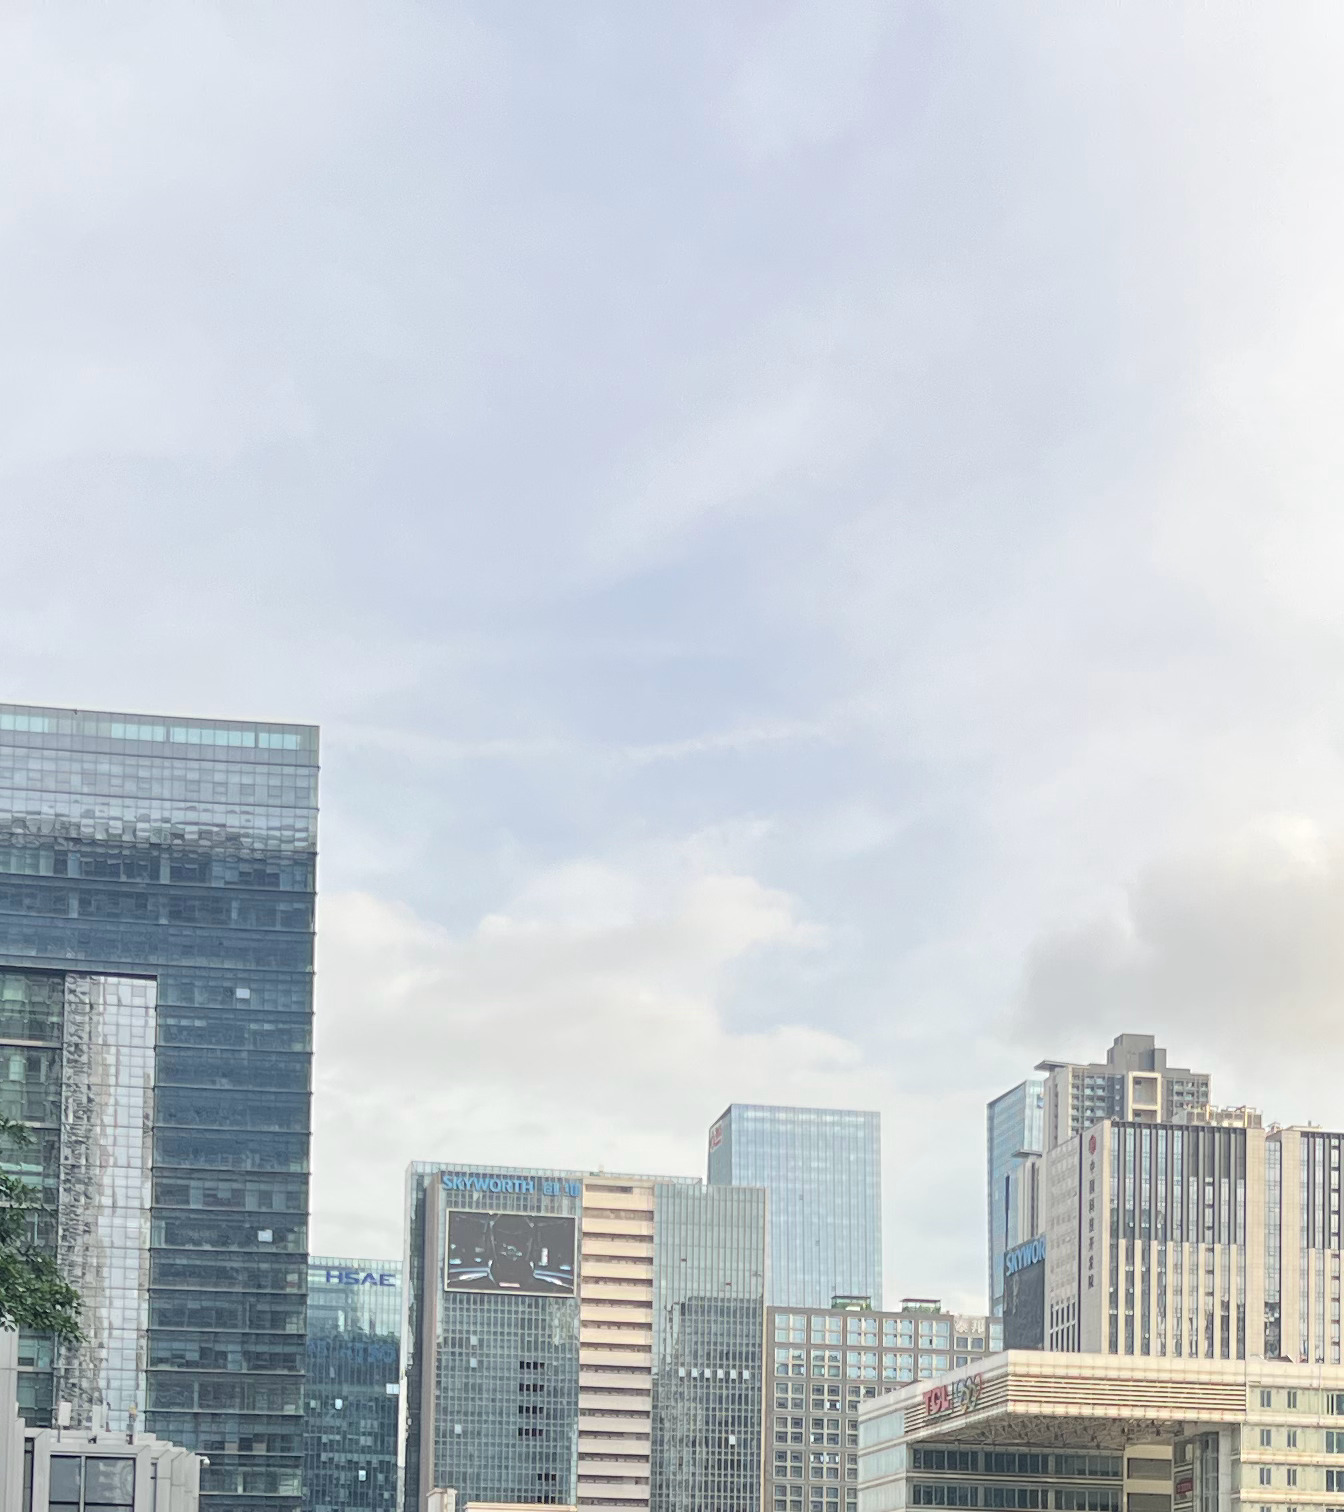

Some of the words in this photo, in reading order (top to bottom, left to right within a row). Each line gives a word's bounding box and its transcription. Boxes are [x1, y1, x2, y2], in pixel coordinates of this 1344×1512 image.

[443, 1175, 534, 1194] SKYWORTH
[326, 1271, 396, 1287] HSAE
[923, 1384, 951, 1415] TCL
